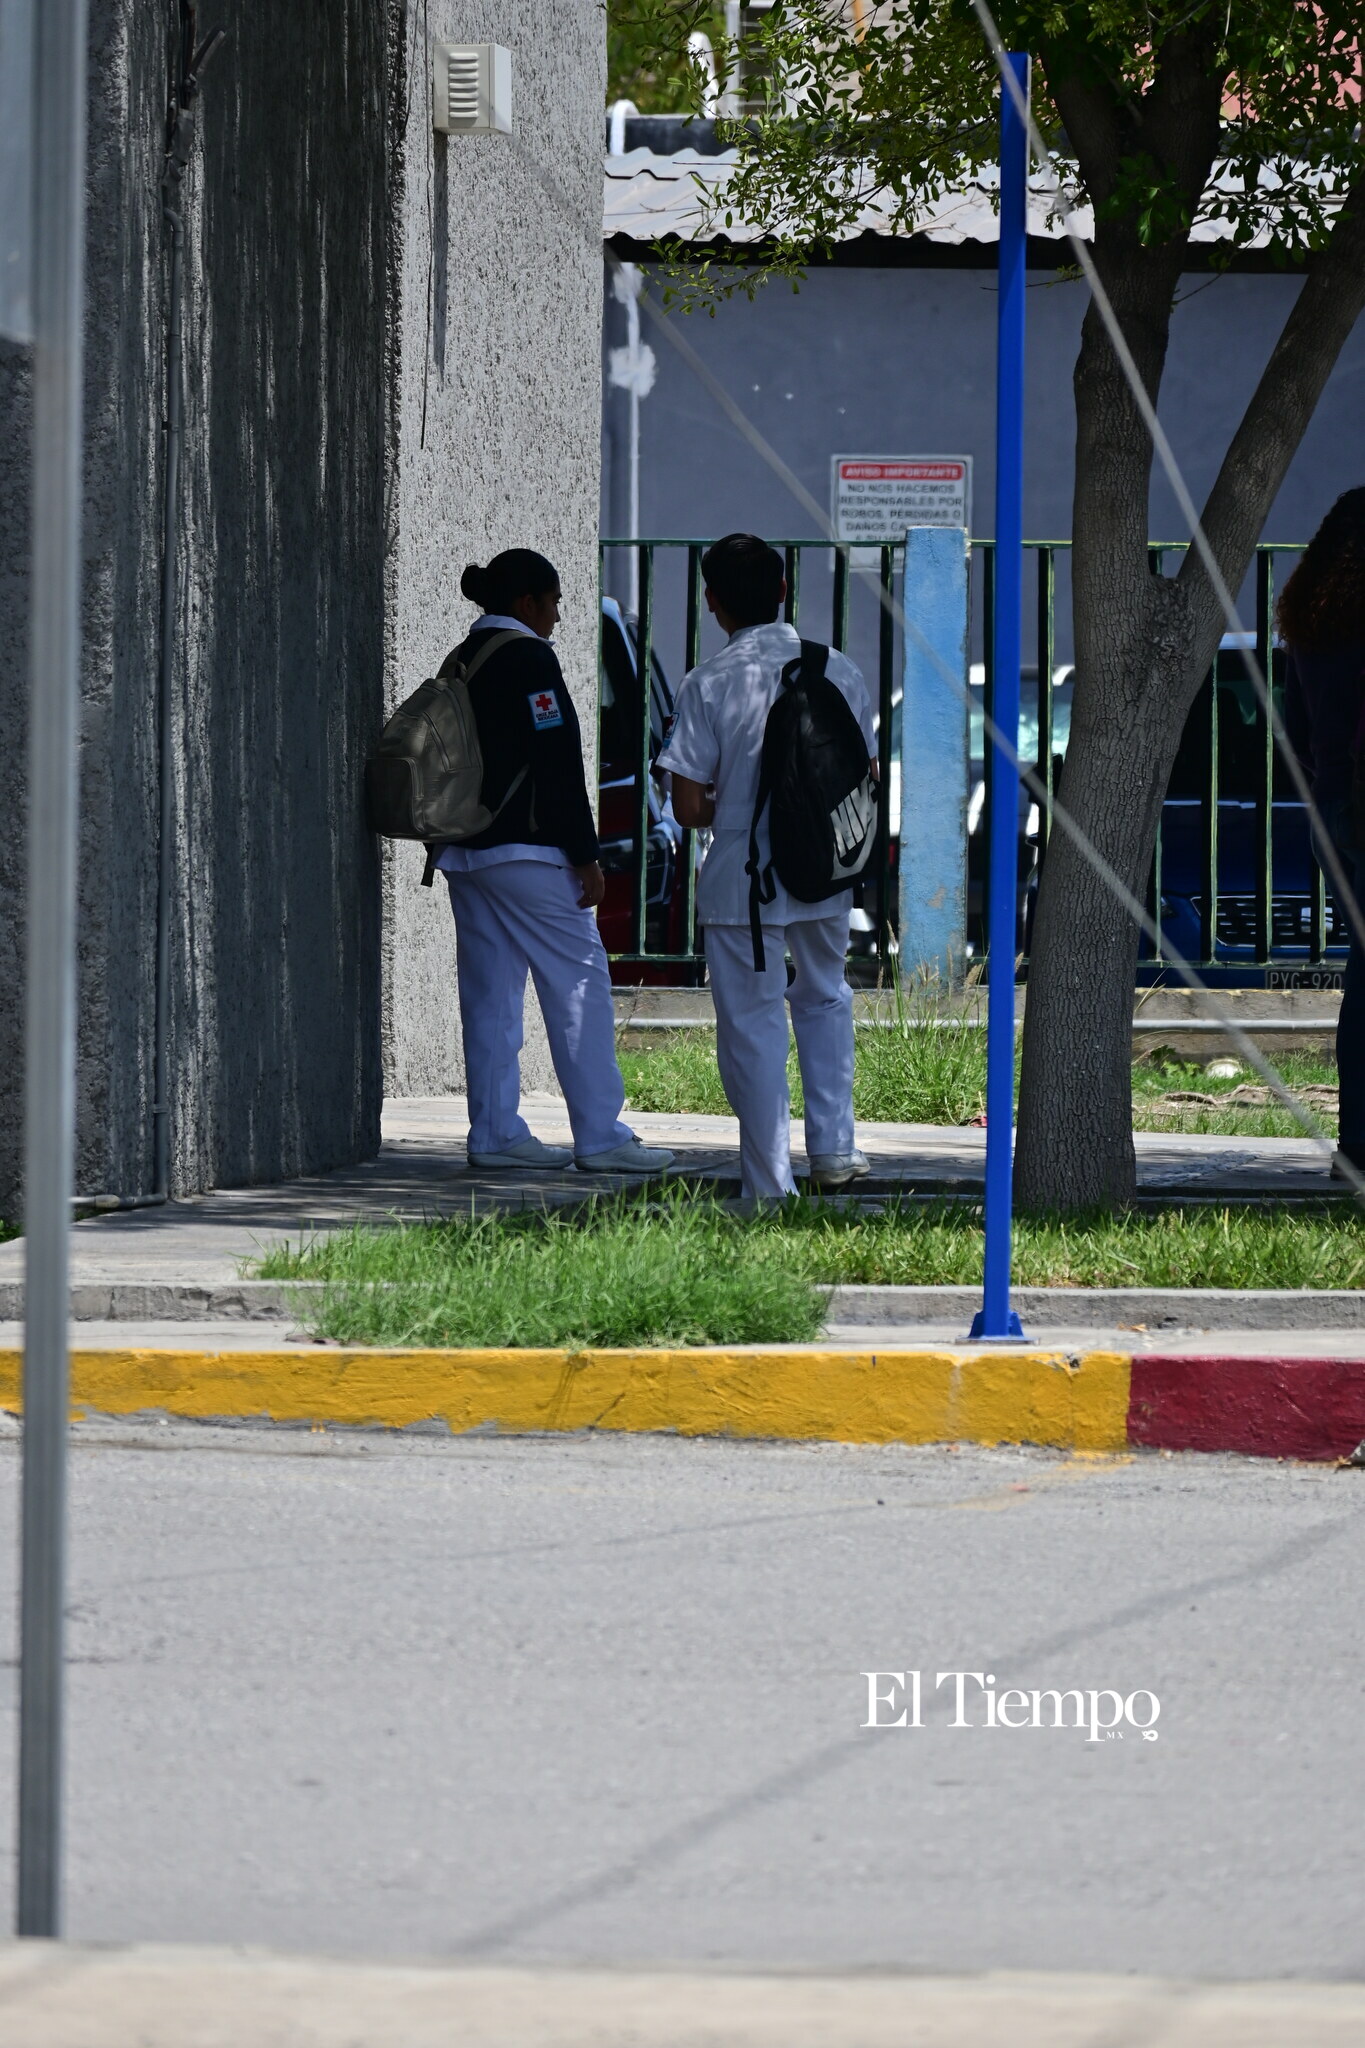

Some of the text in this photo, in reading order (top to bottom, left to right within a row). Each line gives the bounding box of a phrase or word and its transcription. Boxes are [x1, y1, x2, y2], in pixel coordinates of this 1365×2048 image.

[845, 466, 958, 478] AVISO IMPORTANTE
[847, 484, 955, 494] NO NOS HACEMOS
[840, 496, 962, 507] RESPONSABLES POR
[952, 509, 961, 519] O
